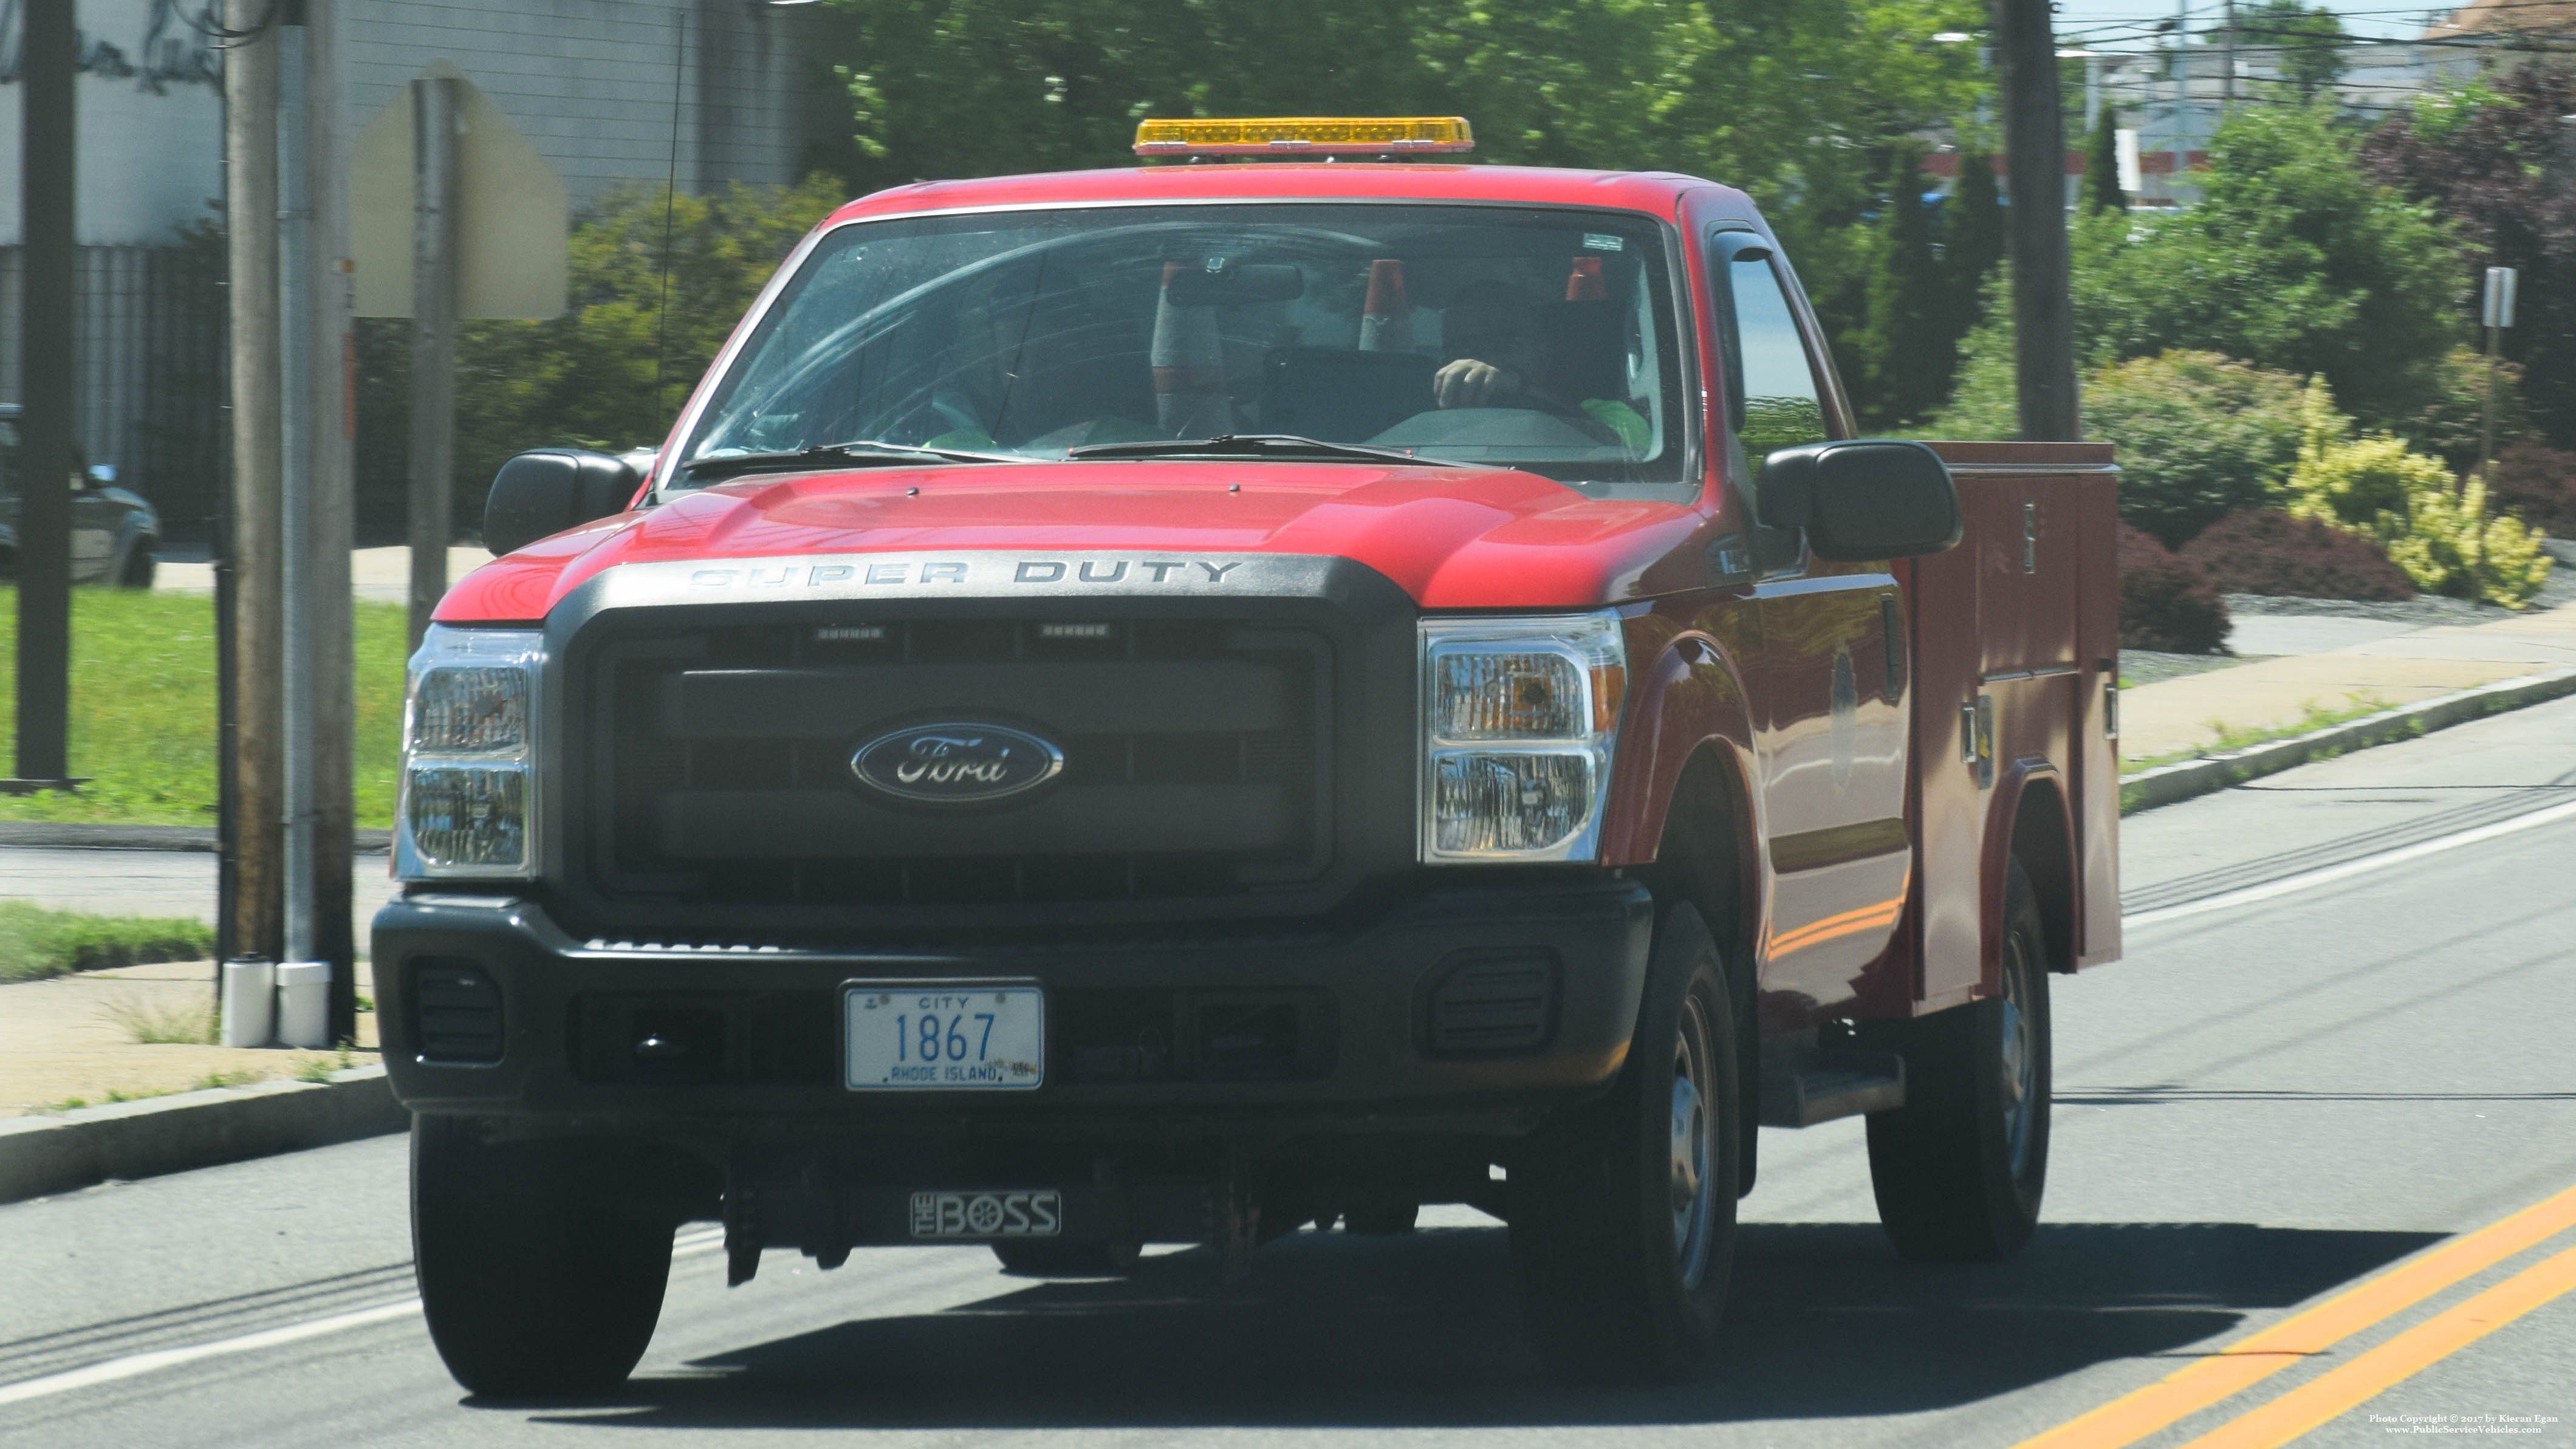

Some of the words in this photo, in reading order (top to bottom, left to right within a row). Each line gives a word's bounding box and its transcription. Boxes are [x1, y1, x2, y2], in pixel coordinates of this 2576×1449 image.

[690, 561, 970, 591] SUPER
[1013, 561, 1243, 584] DUTY
[897, 736, 1010, 783] Ford
[919, 997, 969, 1009] CITY
[897, 1013, 995, 1061] 1867
[891, 1067, 937, 1081] RHODE
[945, 1067, 996, 1081] ISLAND
[914, 1194, 935, 1235] THE
[936, 1193, 1057, 1235] BOSS
